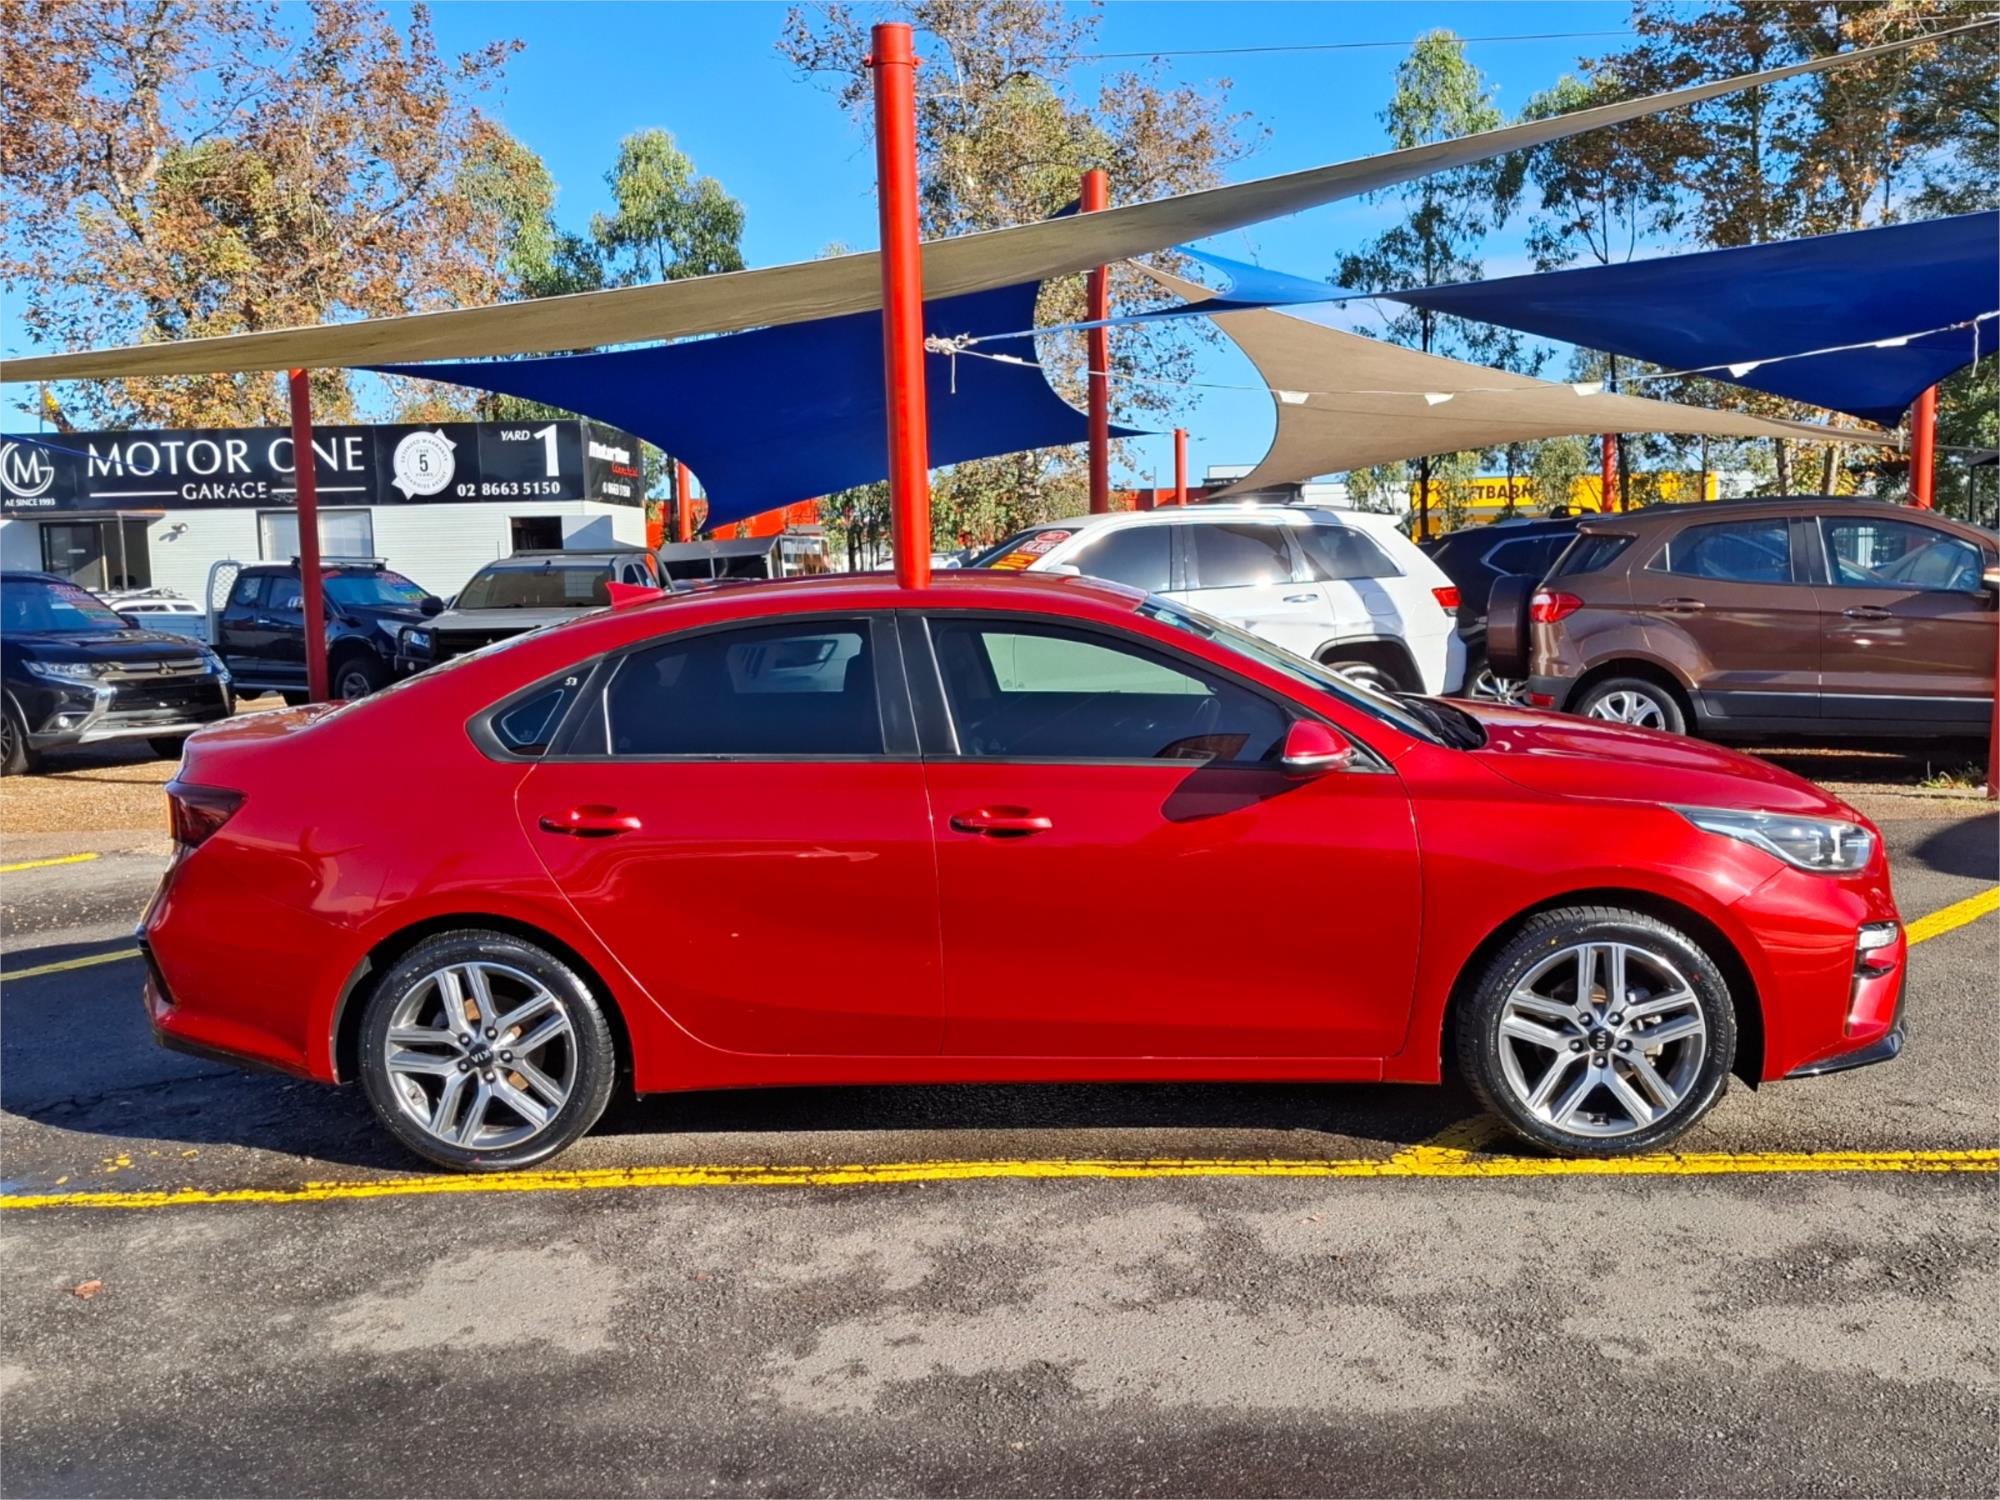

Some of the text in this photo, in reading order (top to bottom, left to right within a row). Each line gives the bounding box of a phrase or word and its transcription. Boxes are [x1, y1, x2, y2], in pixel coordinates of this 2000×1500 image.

[88, 436, 365, 477] MOTOR ONE
[500, 423, 560, 477] YARD 1
[419, 453, 429, 473] 5
[182, 481, 268, 500] GARAGE
[456, 480, 561, 497] 02 8663 5150
[16, 498, 38, 507] SINCE
[470, 1049, 491, 1063] KIA
